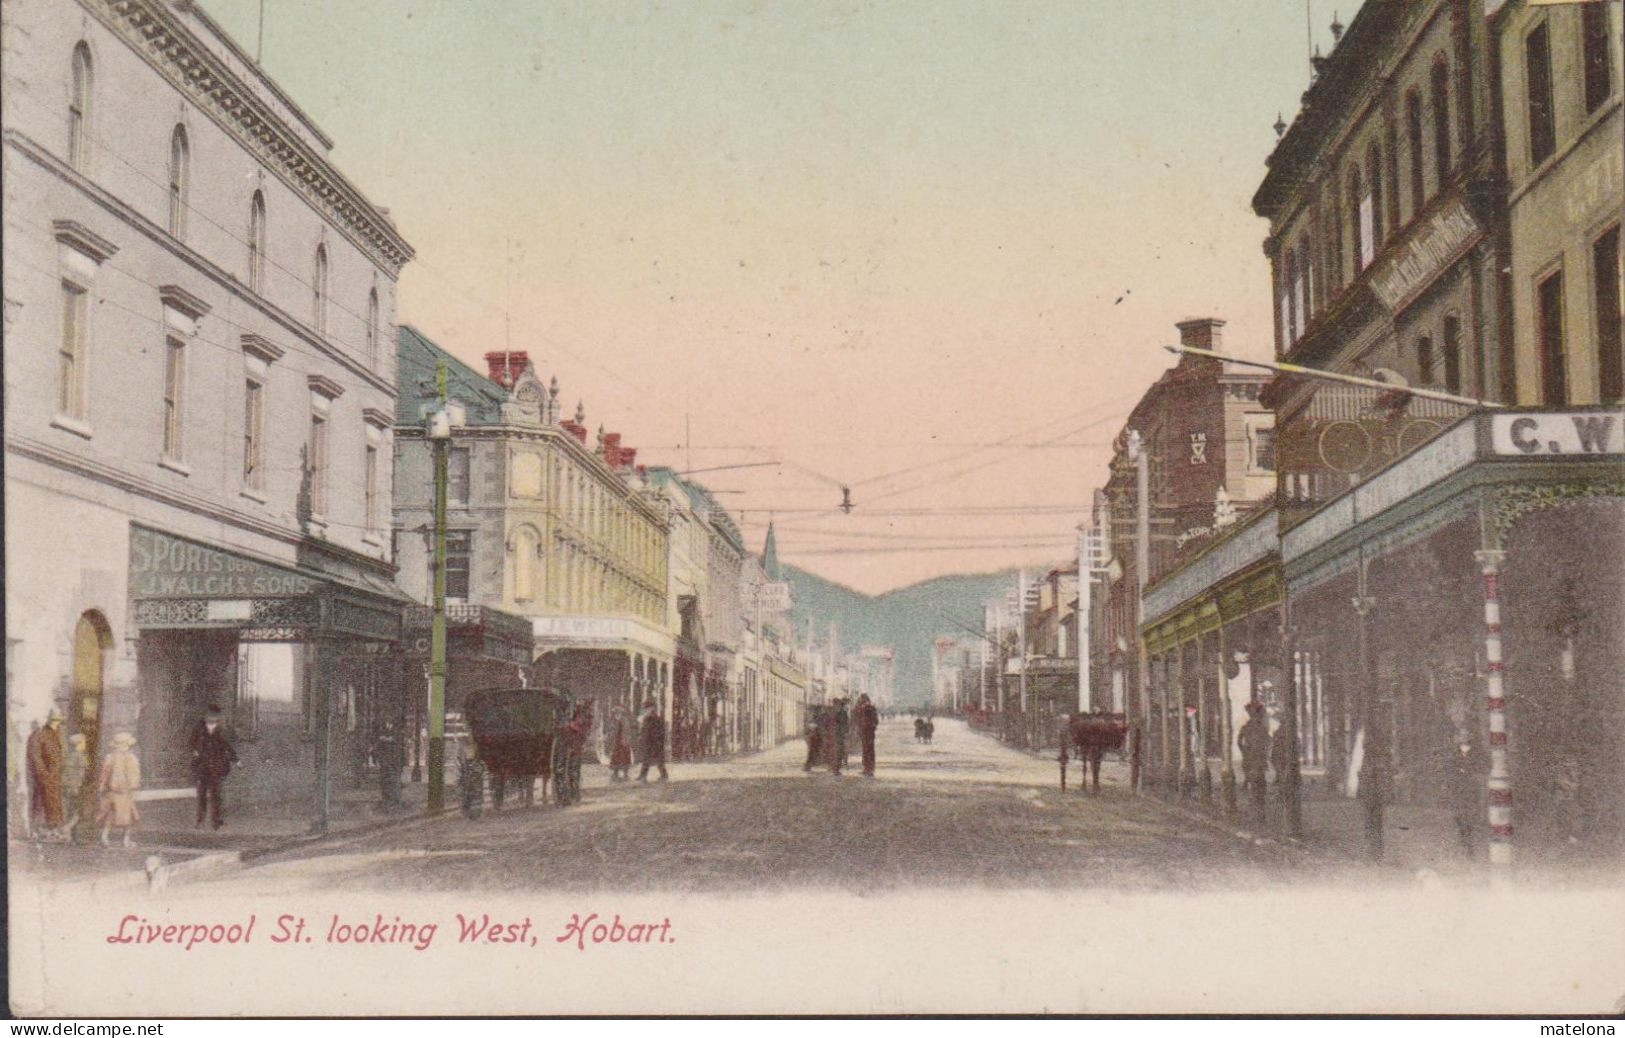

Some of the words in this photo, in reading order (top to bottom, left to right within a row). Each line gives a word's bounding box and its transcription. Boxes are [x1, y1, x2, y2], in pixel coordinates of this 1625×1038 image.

[1510, 417, 1560, 453] C.
[1571, 416, 1616, 453] W
[131, 531, 221, 572] SPORTS
[236, 577, 247, 593] &
[107, 913, 255, 949] Liverpool
[271, 913, 313, 944] St.
[327, 914, 437, 950] looking
[458, 914, 538, 948] West,
[556, 912, 676, 952] Hobart.
